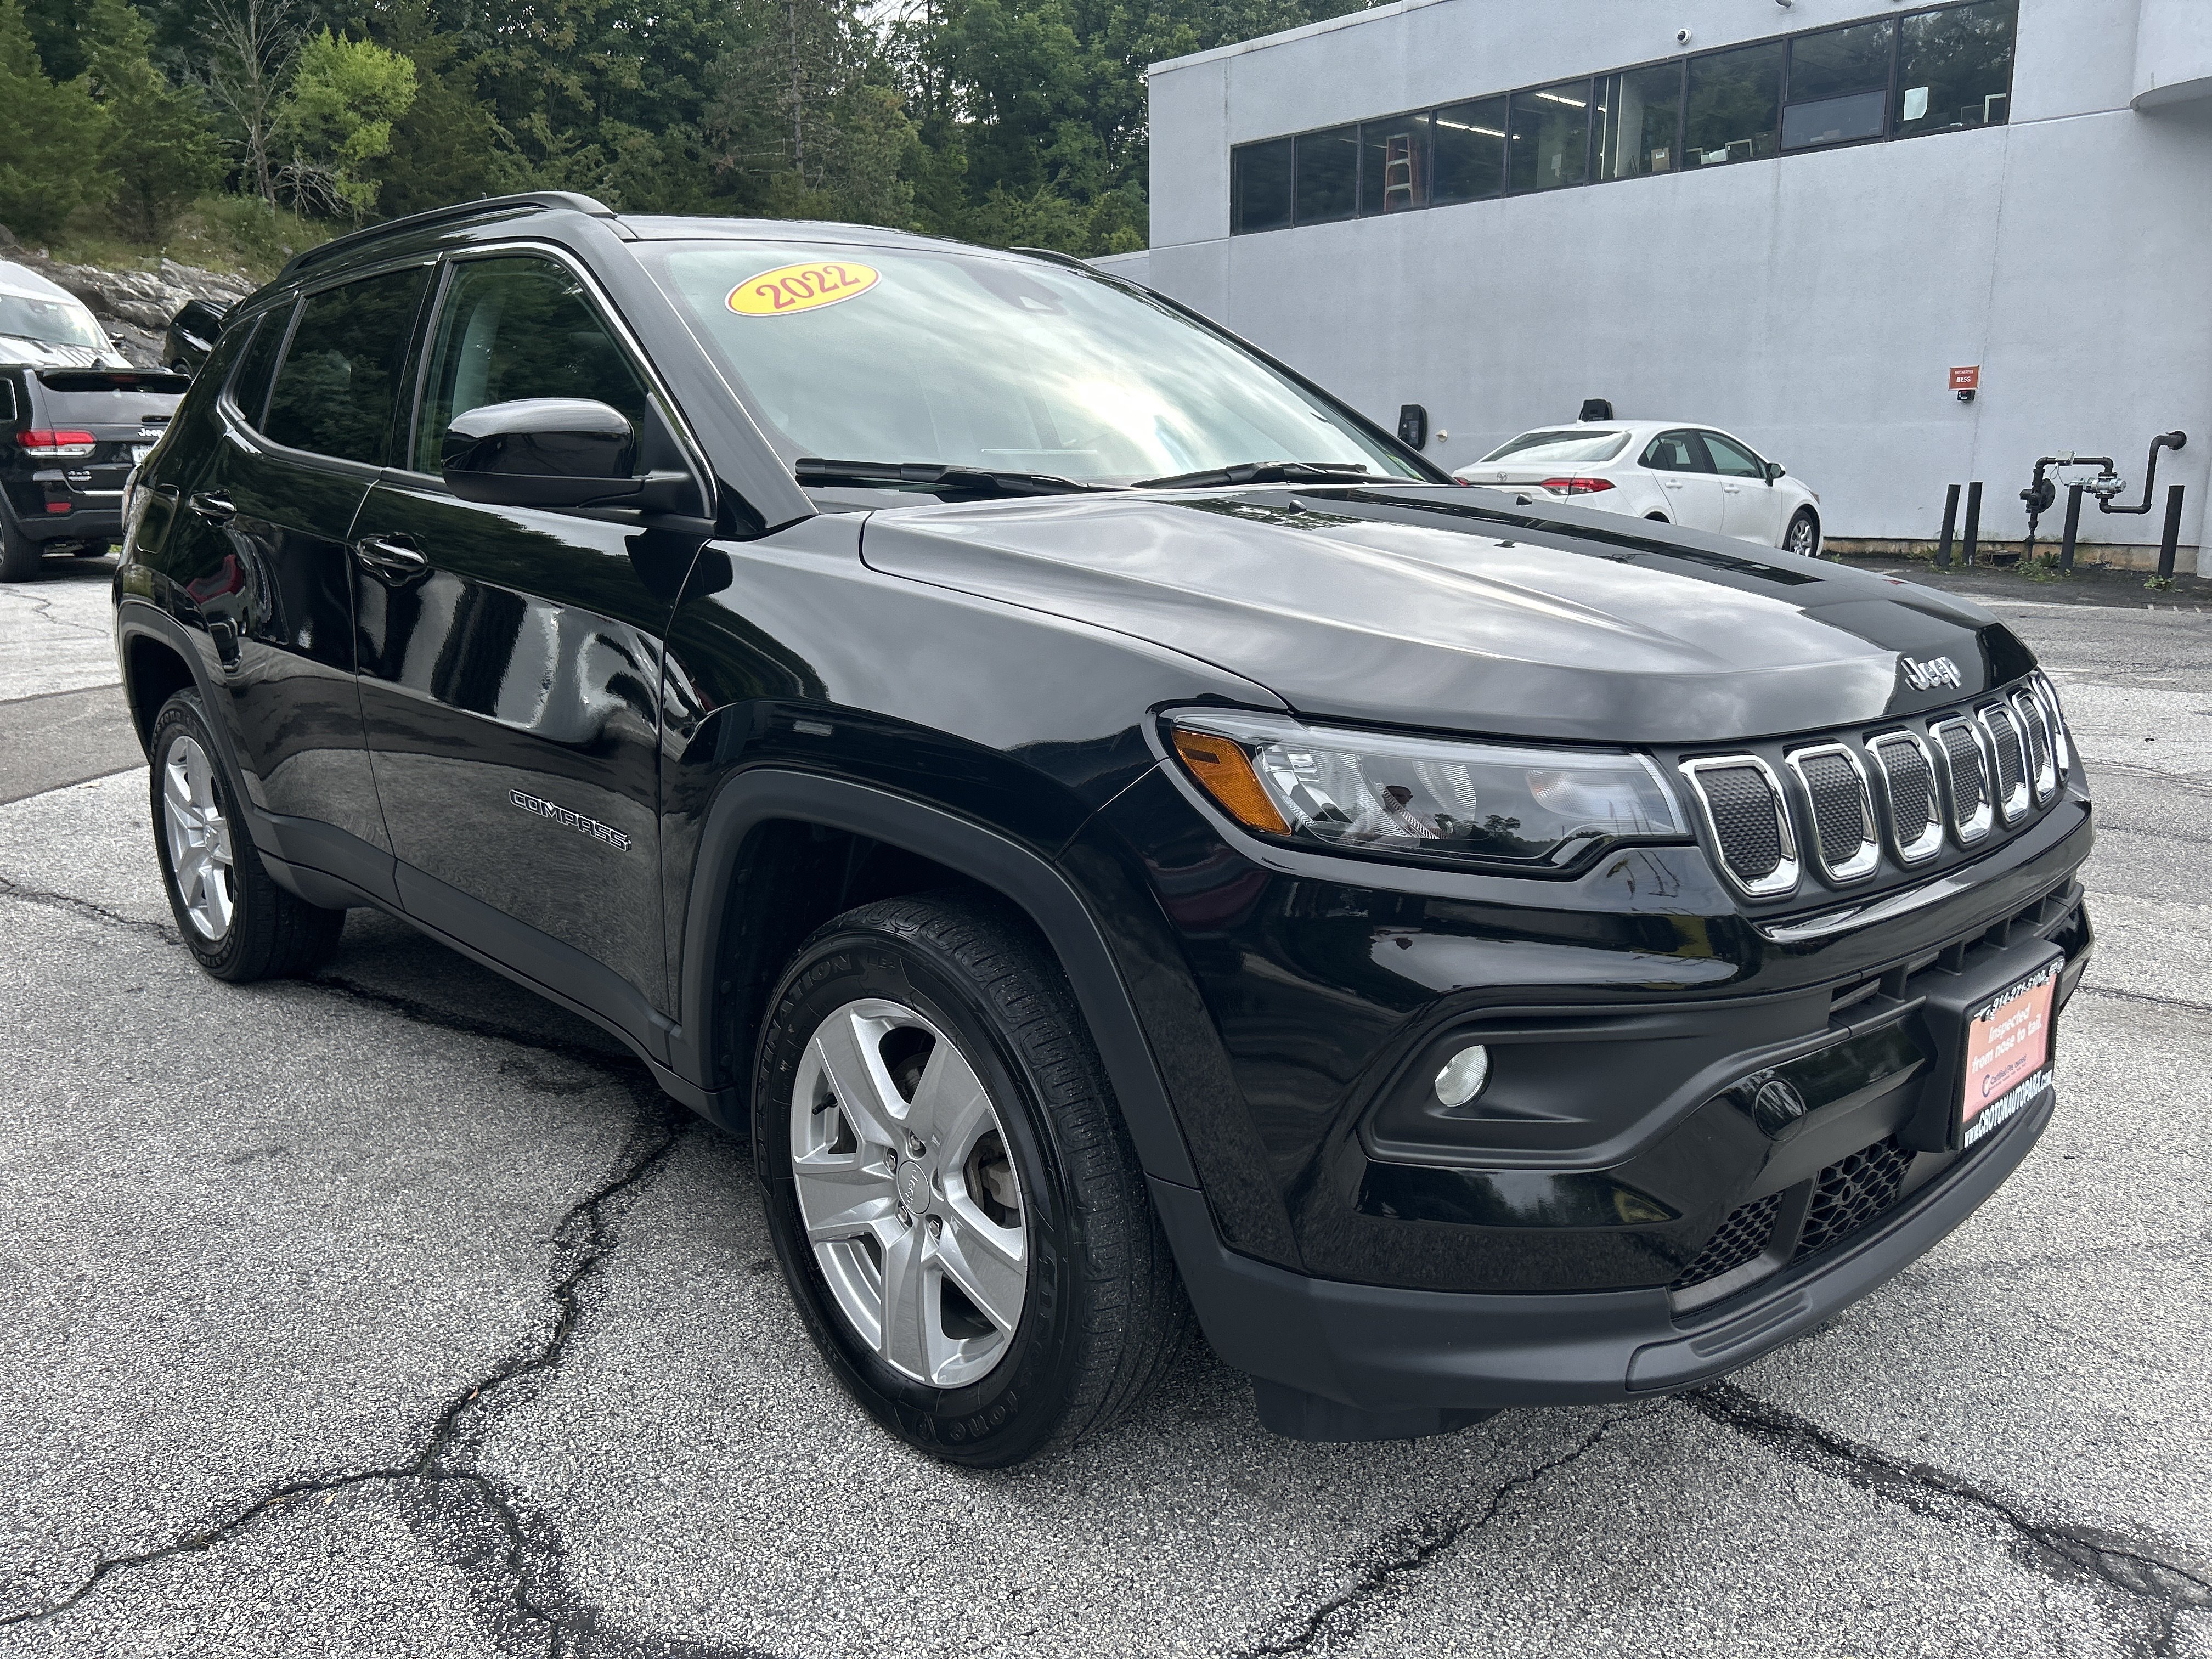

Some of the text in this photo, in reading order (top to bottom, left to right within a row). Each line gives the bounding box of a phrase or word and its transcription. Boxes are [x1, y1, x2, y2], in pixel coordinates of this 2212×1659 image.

[755, 265, 861, 310] 2022
[138, 428, 165, 439] Jeep
[1901, 656, 1962, 691] Jeep
[509, 789, 632, 851] COMPASS
[1989, 1002, 2032, 1043] Inspected
[756, 953, 853, 1177] DESTINATION
[1972, 1049, 1993, 1074] from
[1995, 1035, 2016, 1058] nose
[2017, 1028, 2025, 1043] to
[905, 1169, 919, 1204] Jeep
